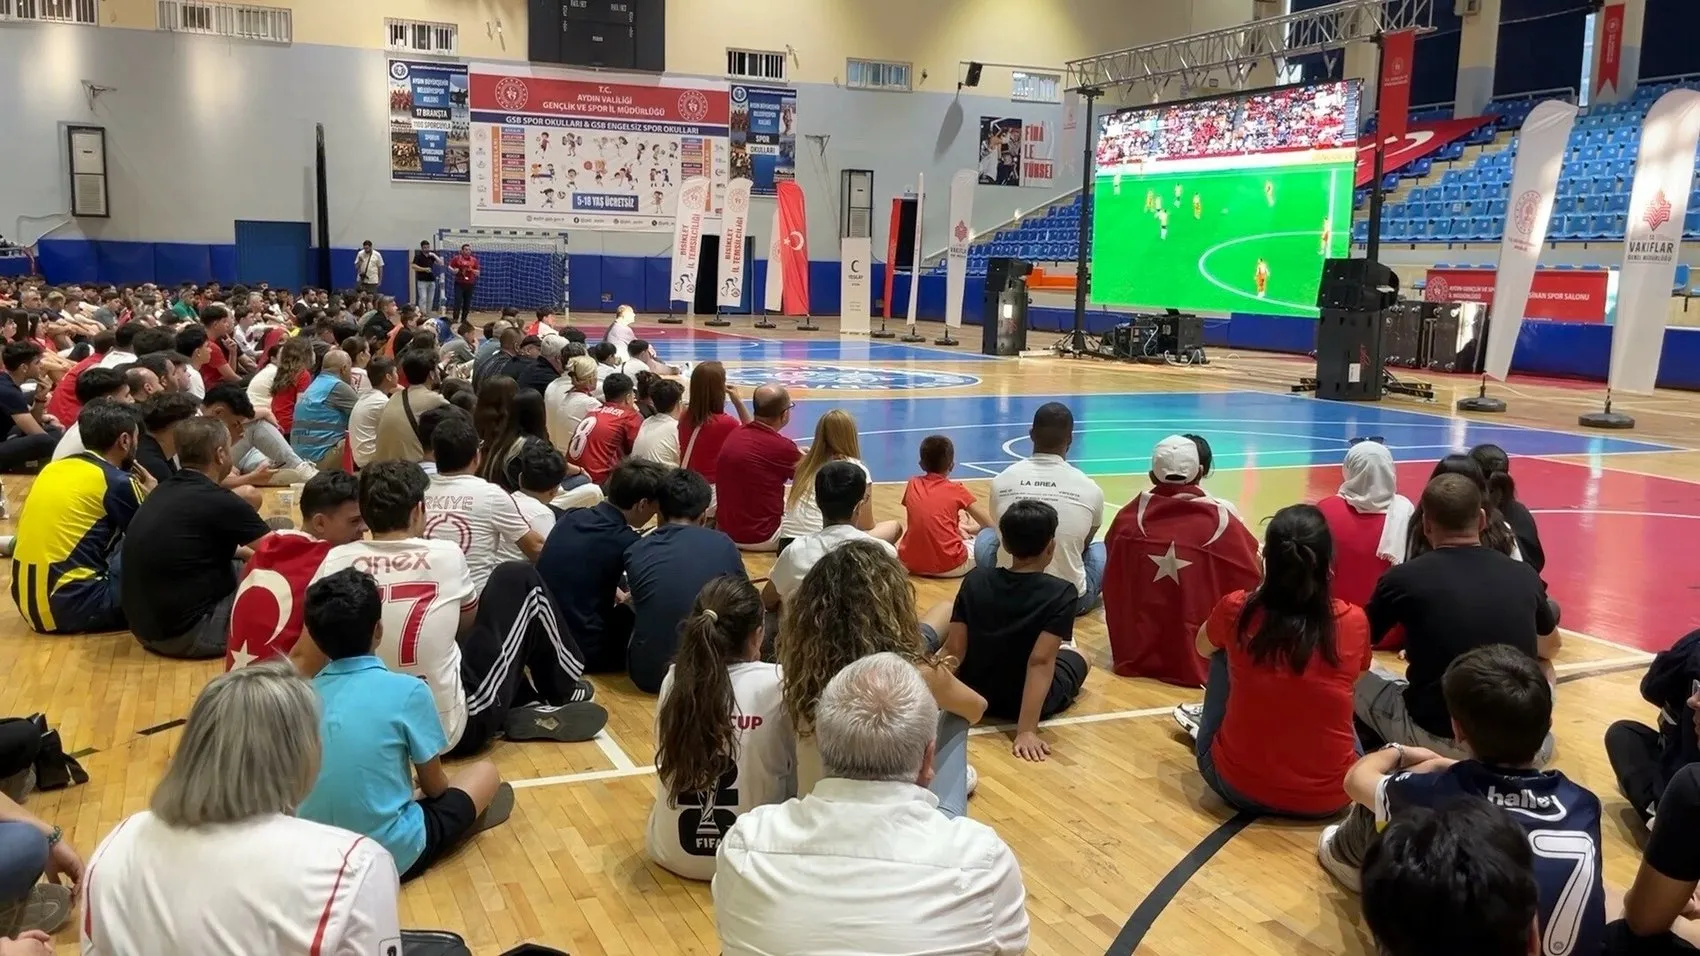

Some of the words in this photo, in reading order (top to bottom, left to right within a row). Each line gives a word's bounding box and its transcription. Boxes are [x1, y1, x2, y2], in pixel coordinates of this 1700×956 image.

[598, 86, 612, 94] T.C.
[577, 94, 601, 103] AYDIN
[601, 95, 633, 105] VALİLİĞİ
[543, 101, 576, 111] GENÇLİK
[576, 104, 587, 112] VE
[609, 104, 616, 113] İL
[617, 106, 666, 116] MÜDÜRLÜĞÜ
[506, 116, 522, 124] GSB
[523, 116, 544, 126] SPOR
[544, 117, 584, 127] OKULLARI
[584, 120, 591, 128] &
[591, 120, 606, 129] GSB
[607, 121, 642, 131] ENGELSİZ
[643, 123, 663, 132] SPOR
[663, 124, 699, 134] OKULLARI
[755, 135, 770, 143] SPOR
[750, 146, 776, 154] OKULLARI
[577, 196, 592, 206] 5-18
[592, 196, 604, 208] YAŞ
[605, 195, 635, 208] ÜCRETSİZ
[1629, 242, 1674, 253] VAKIFLAR
[1564, 293, 1590, 301] SALONU
[569, 416, 597, 461] 8
[352, 551, 432, 575] anex
[376, 581, 439, 667] 7
[1528, 829, 1596, 956] 7
